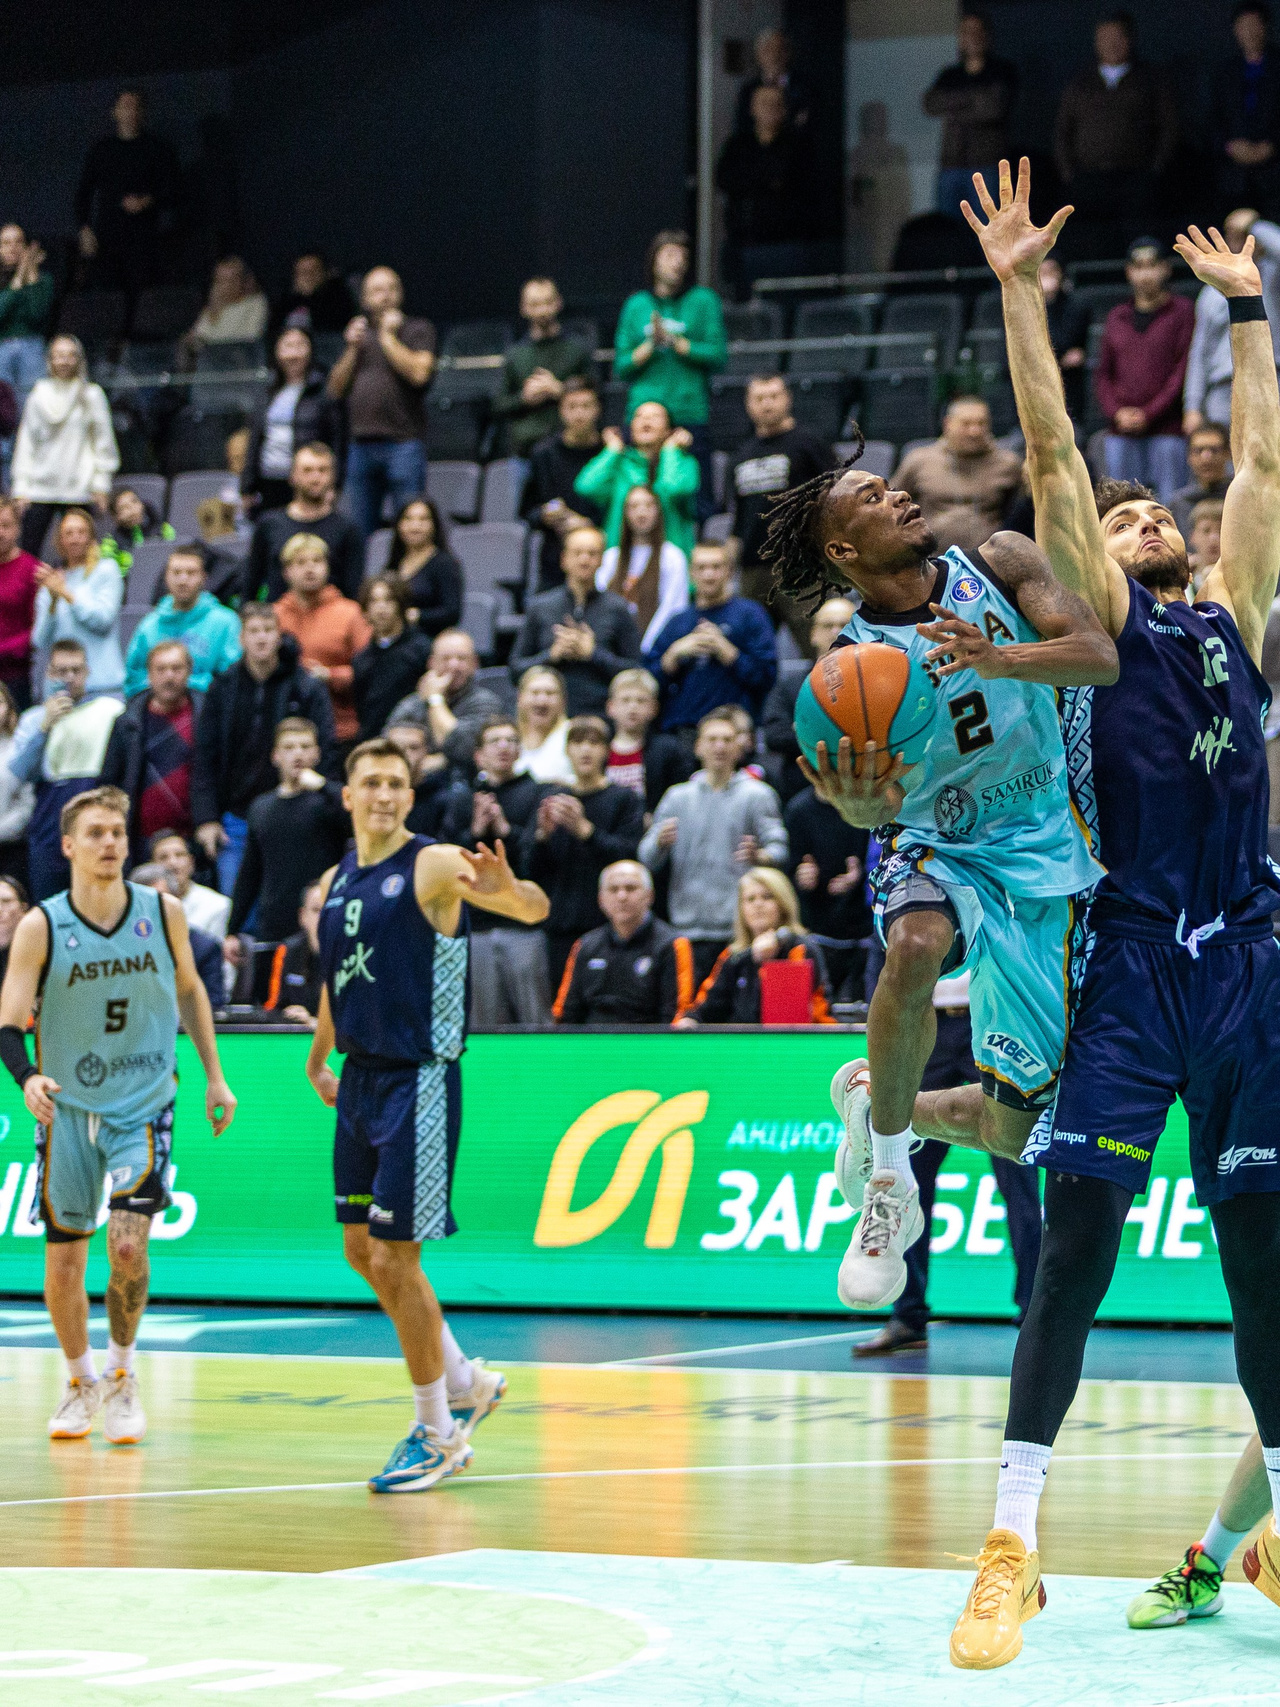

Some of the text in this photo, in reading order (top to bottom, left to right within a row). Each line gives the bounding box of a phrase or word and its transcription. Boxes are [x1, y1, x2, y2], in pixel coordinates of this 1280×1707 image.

[1198, 636, 1230, 687] 12
[948, 689, 995, 756] 2
[980, 764, 1055, 807] SAMRUK
[344, 898, 363, 937] 9
[68, 951, 158, 988] ASTANA
[105, 998, 130, 1034] 5
